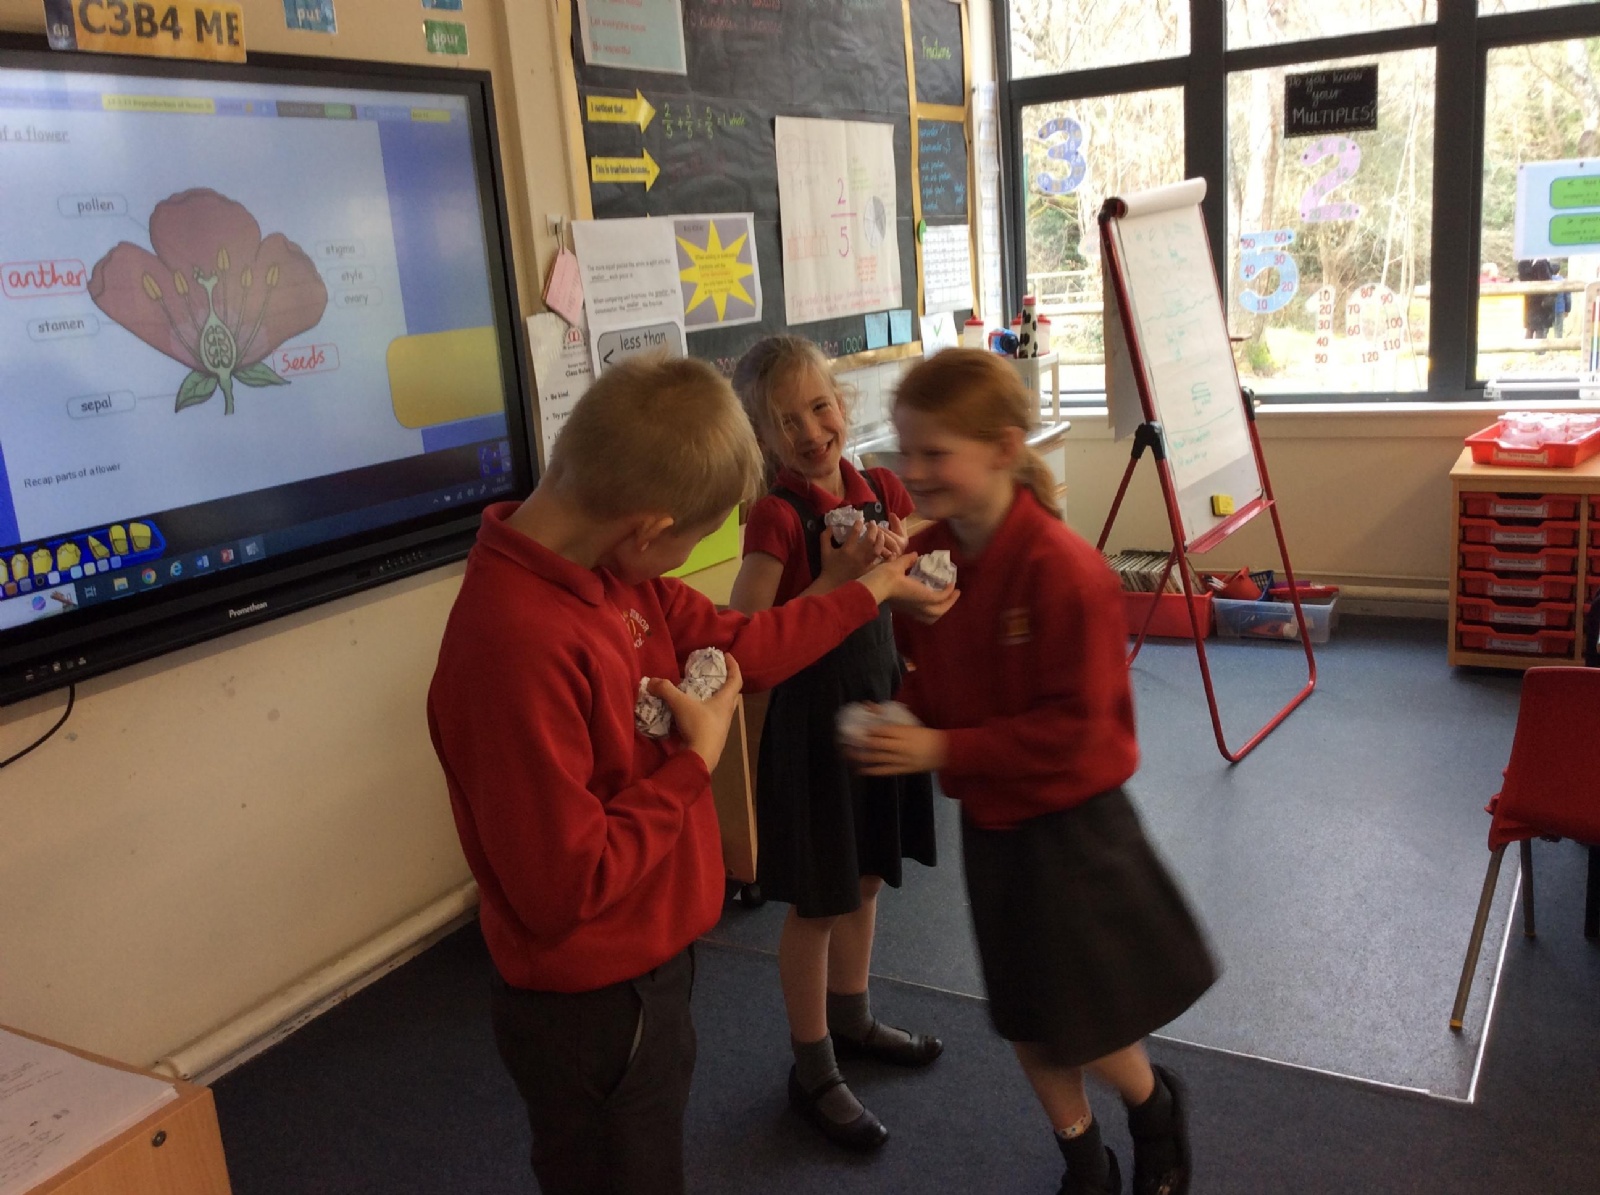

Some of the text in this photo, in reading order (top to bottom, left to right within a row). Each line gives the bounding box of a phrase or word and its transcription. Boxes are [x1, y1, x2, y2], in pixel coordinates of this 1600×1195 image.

[79, 0, 240, 46] C3B4 ME
[297, 8, 321, 27] put
[432, 31, 460, 49] your
[1306, 74, 1326, 94] you
[1332, 70, 1363, 84] know
[1312, 89, 1341, 108] your
[27, 124, 69, 142] flower
[1038, 117, 1086, 194] 3
[1301, 135, 1361, 222] 2
[836, 178, 847, 205] 2
[77, 198, 114, 217] pollen
[838, 226, 850, 257] 5
[8, 262, 86, 288] anther
[1239, 229, 1298, 313] 5
[1361, 287, 1373, 299] 80
[1381, 293, 1393, 305] 90
[1319, 303, 1331, 315] 20
[1348, 303, 1360, 315] 70
[38, 318, 85, 334] stamen
[1318, 319, 1330, 330] 30
[1347, 324, 1360, 336] 60
[1386, 316, 1403, 330] 100
[619, 330, 667, 351] less than
[1317, 336, 1329, 347] 40
[1383, 338, 1400, 351] 110
[281, 345, 326, 373] Seeds
[1315, 353, 1328, 364] 50
[1362, 351, 1379, 363] 120
[81, 394, 112, 413] sepal
[24, 474, 53, 489] Recap
[55, 469, 77, 484] parts
[78, 467, 87, 479] of
[95, 462, 121, 475] flower
[229, 601, 268, 618] Promethean
